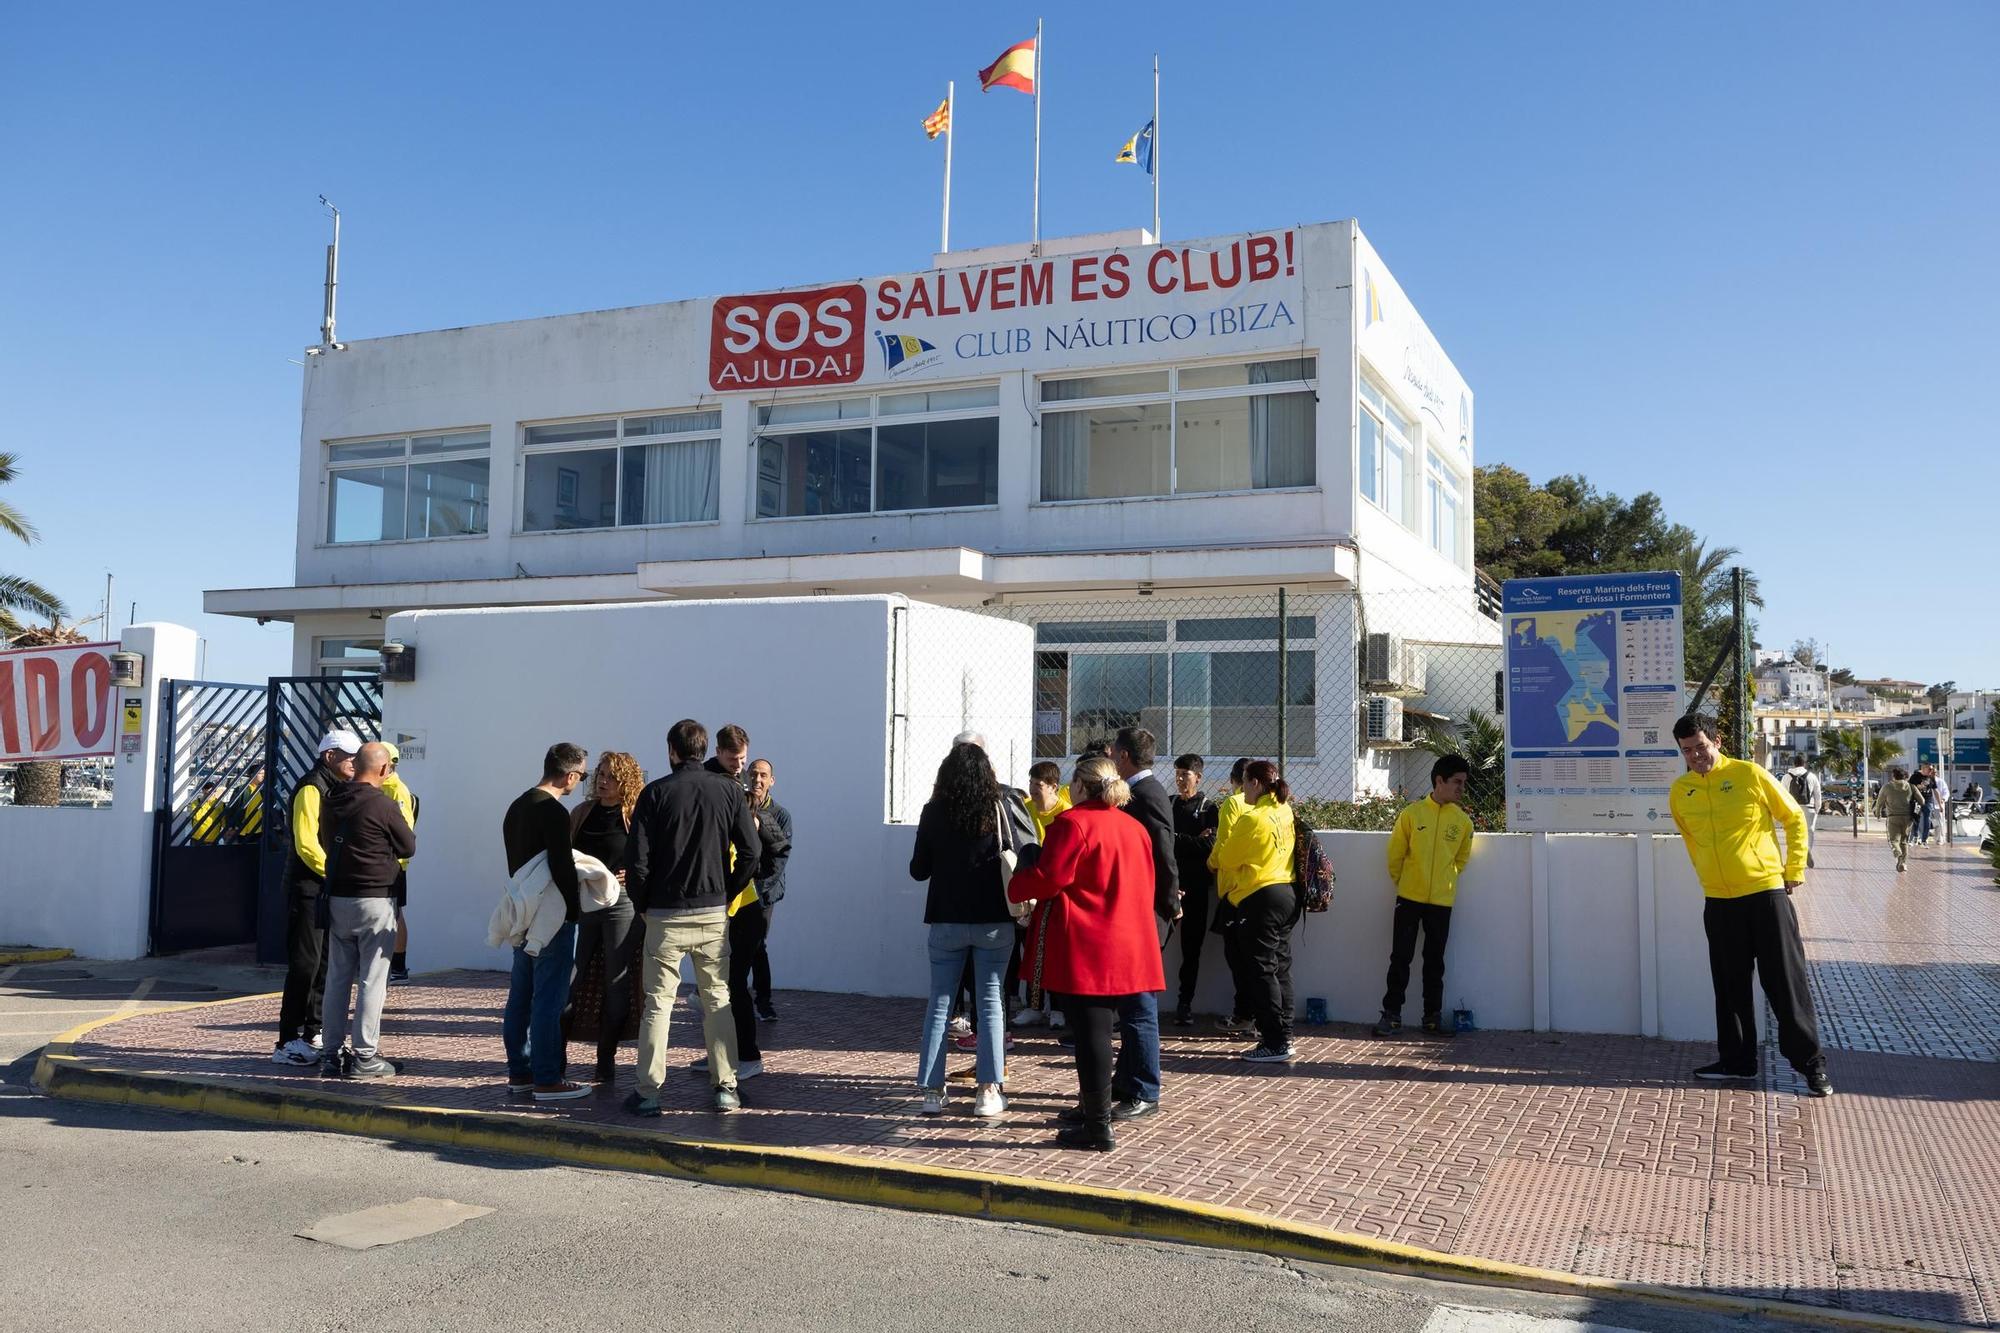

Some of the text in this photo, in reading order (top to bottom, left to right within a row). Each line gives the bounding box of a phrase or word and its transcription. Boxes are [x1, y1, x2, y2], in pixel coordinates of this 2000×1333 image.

[876, 231, 1294, 321] SALVEM ES CLUB!
[723, 298, 852, 354] SOS
[955, 328, 1031, 359] CLUB
[1045, 314, 1197, 351] NÁUTICO
[1209, 300, 1295, 336] IBIZA
[717, 353, 851, 384] AJUDA!
[1558, 583, 1671, 596] Reserva Marina dels Freus
[1620, 592, 1671, 601] Formentera
